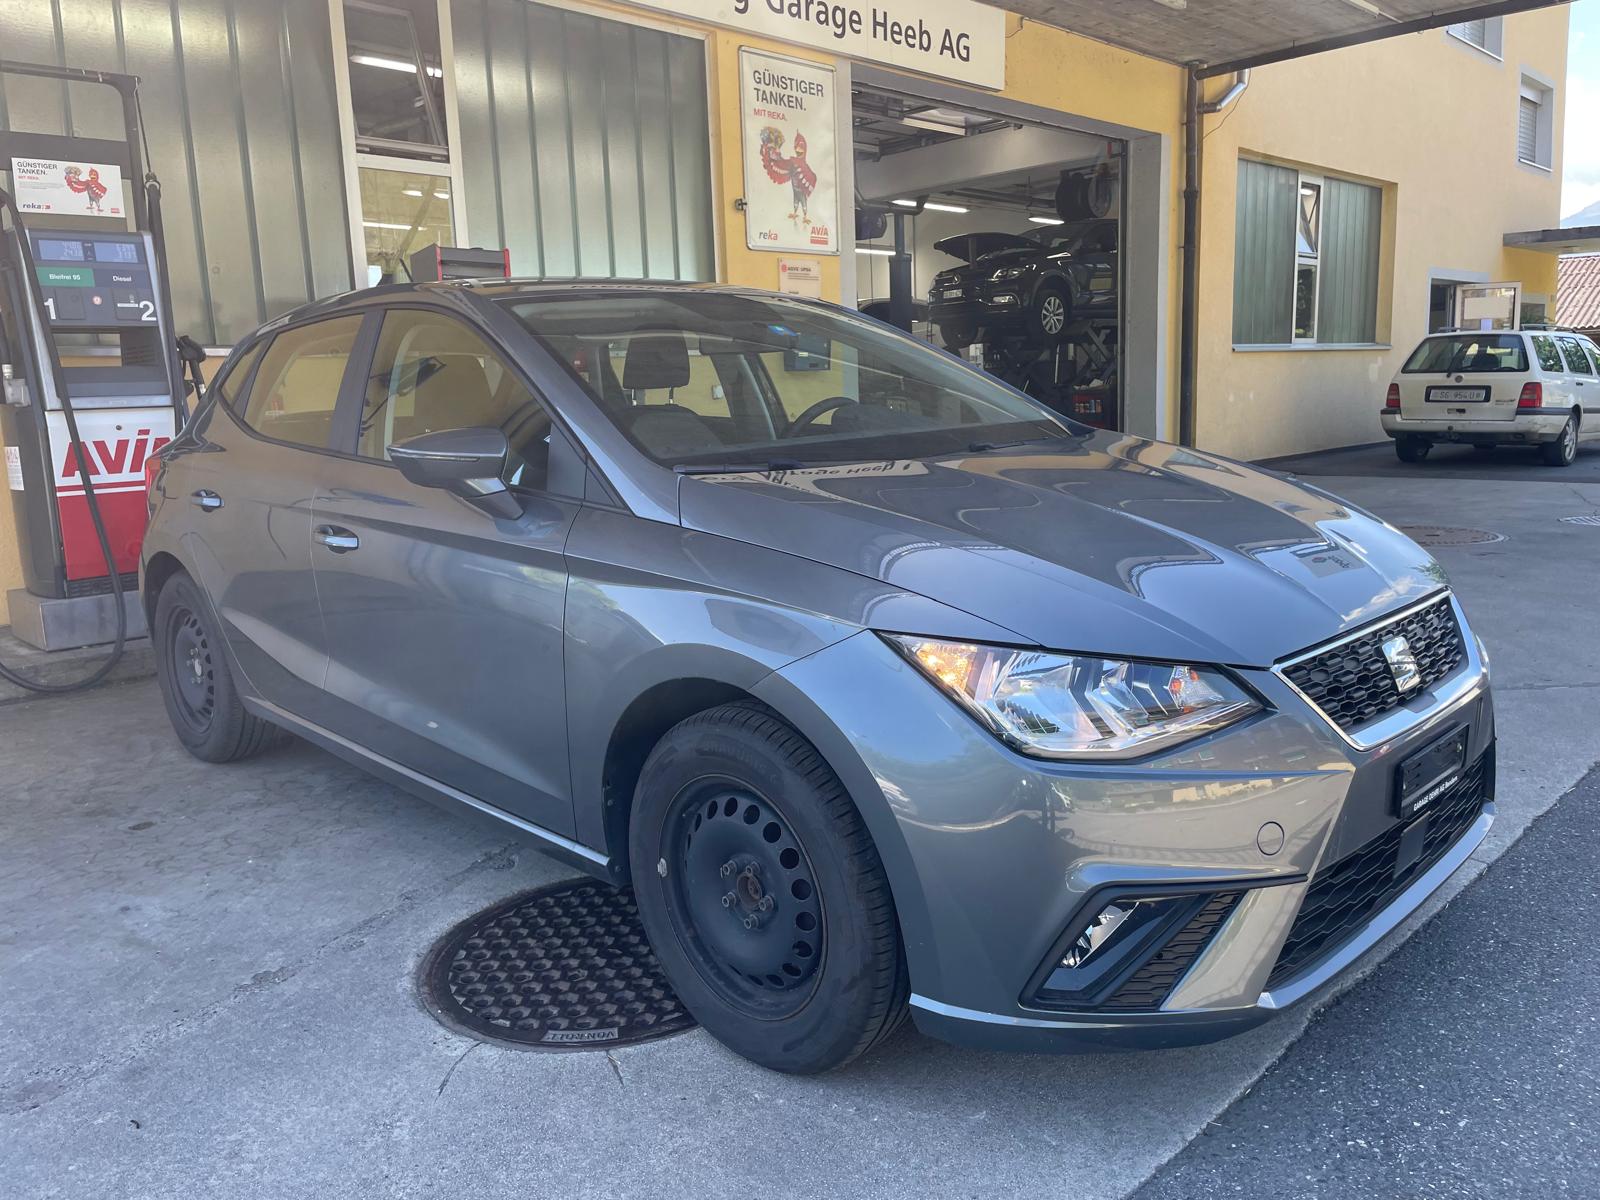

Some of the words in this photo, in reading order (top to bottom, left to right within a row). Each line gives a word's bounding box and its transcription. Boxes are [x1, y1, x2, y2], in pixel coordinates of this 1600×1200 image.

[872, 8, 931, 52] Heeb
[939, 28, 970, 62] AG
[753, 68, 824, 97] GÜNSTIGER
[753, 88, 806, 111] TANKEN.
[753, 108, 766, 117] MIT
[17, 161, 57, 170] GÜNSTIGER
[17, 168, 48, 176] TANKEN.
[758, 229, 778, 241] reka
[44, 298, 57, 320] 1
[139, 300, 157, 321] 2
[62, 429, 172, 478] AVI
